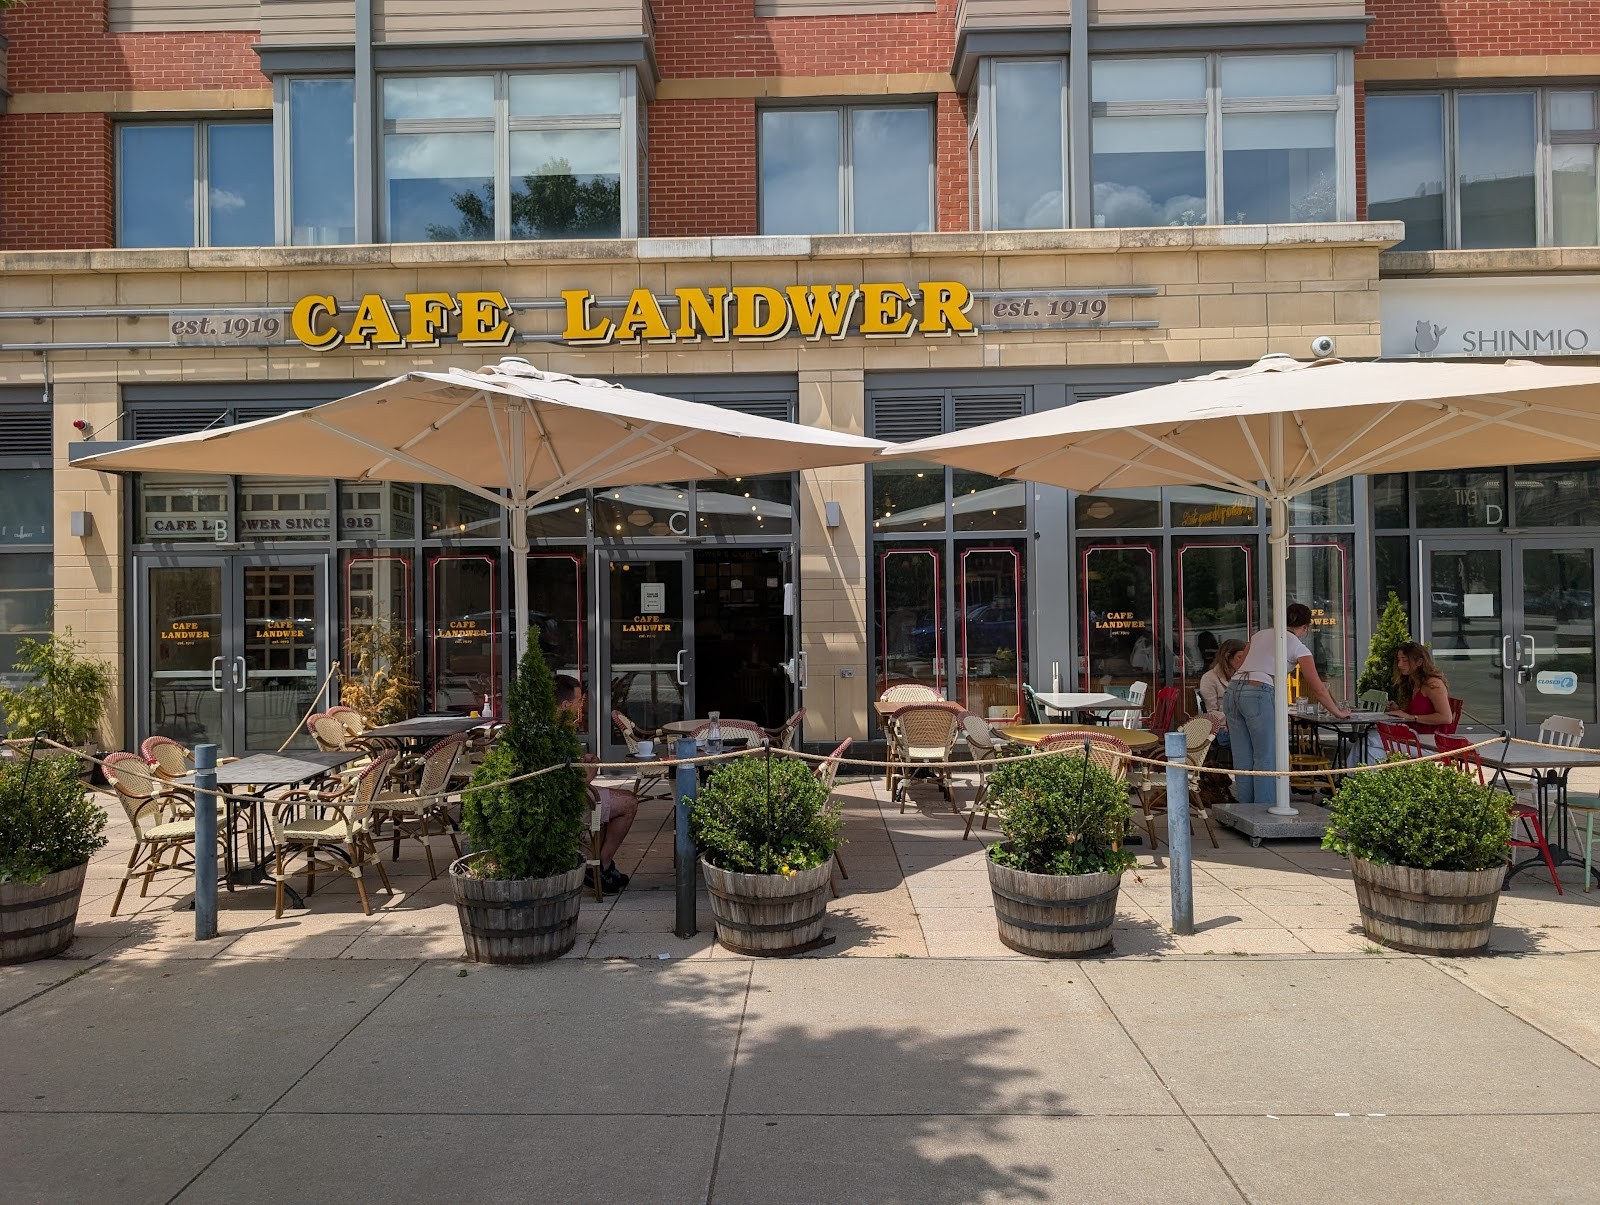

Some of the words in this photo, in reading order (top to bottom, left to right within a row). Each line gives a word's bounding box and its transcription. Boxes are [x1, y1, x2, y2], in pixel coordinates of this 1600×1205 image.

[992, 298, 1039, 318] est.
[1046, 299, 1107, 320] 1919
[292, 290, 515, 351] CAFE
[561, 281, 978, 345] LANDWER
[171, 317, 217, 336] est.
[221, 318, 280, 339] 1919
[1462, 328, 1589, 352] SHINMIO
[1486, 504, 1503, 525] D
[154, 519, 197, 532] CAFE
[286, 517, 331, 530] SINCE
[668, 512, 687, 534] C
[214, 519, 228, 541] B
[633, 615, 660, 623] CAFE
[1106, 611, 1134, 620] CAFE
[172, 622, 199, 630] CAFE
[267, 621, 293, 629] CAFE
[449, 620, 476, 629] CAFE
[622, 624, 672, 632] LANDWER
[1095, 620, 1146, 629] LANDWER
[161, 631, 210, 639] LANDWER
[256, 629, 304, 638] LANDWER
[438, 629, 488, 638] LANDWER
